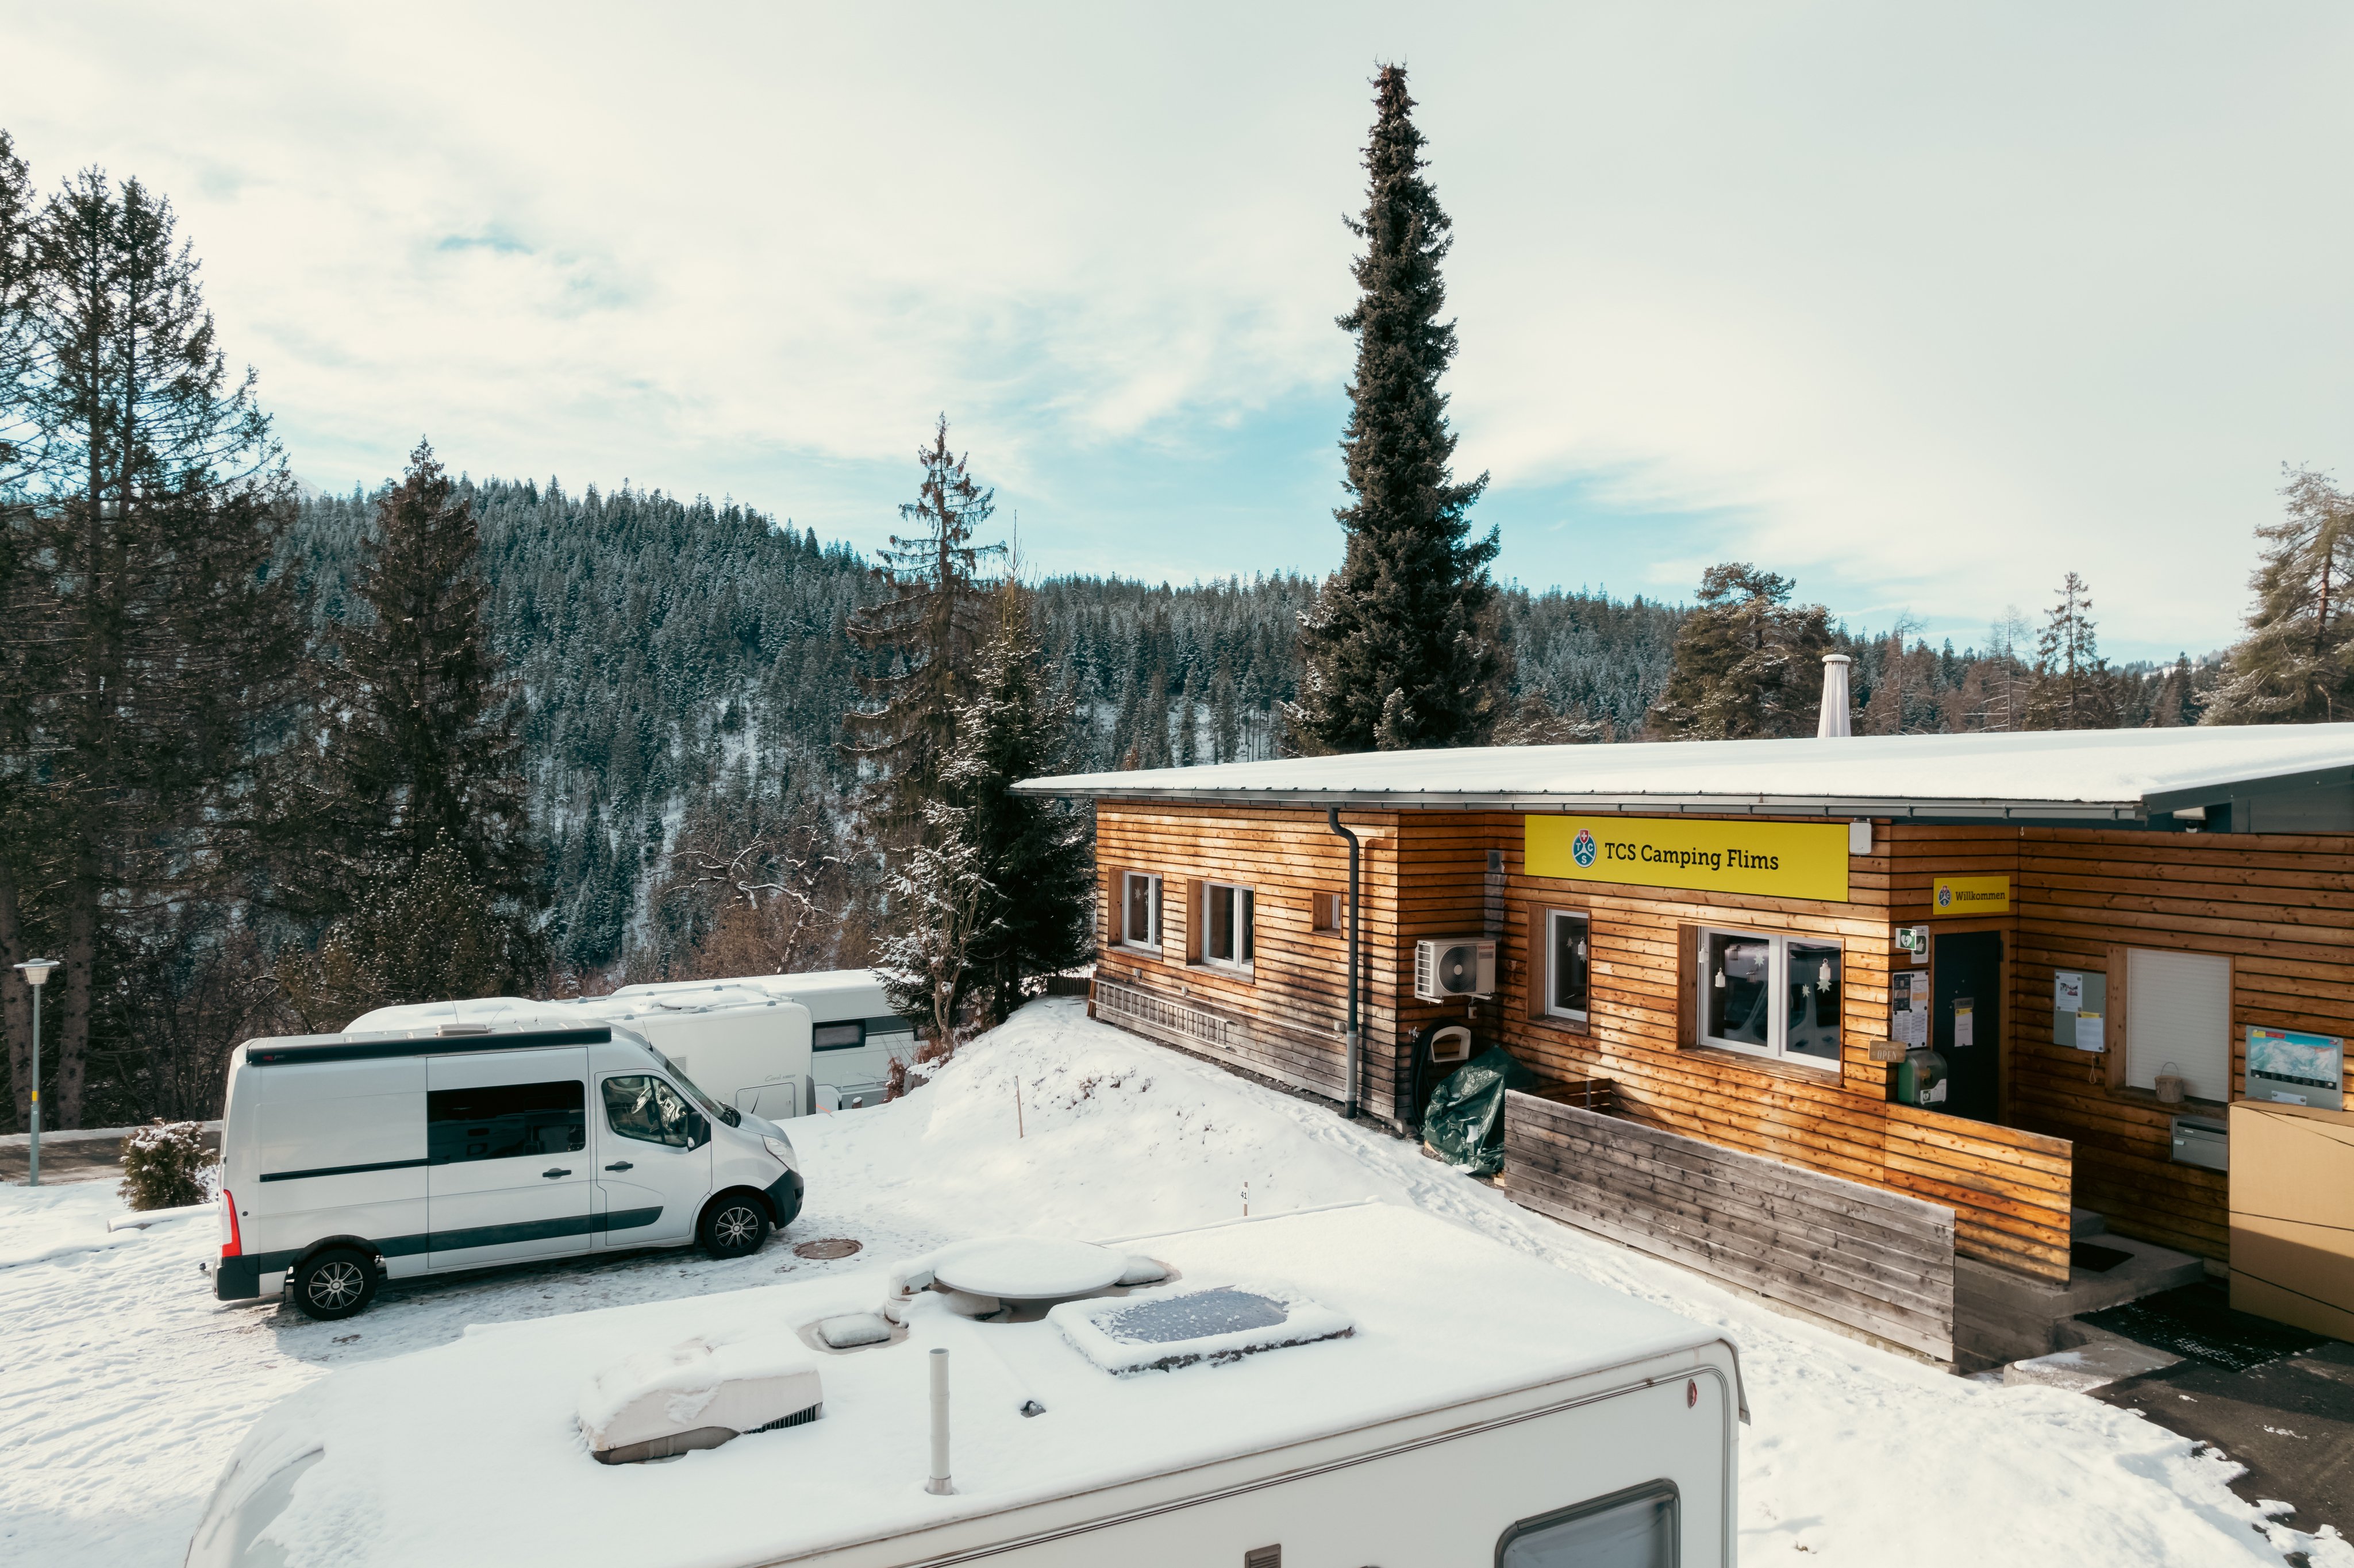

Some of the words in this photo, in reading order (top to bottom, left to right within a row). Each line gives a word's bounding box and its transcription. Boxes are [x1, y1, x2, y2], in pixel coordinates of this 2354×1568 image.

[1605, 842, 1636, 861] TCS
[1641, 844, 1721, 870] Camping
[1727, 849, 1779, 870] Flims
[1955, 891, 2005, 901] Willkommen
[1877, 1050, 1897, 1060] OPEN
